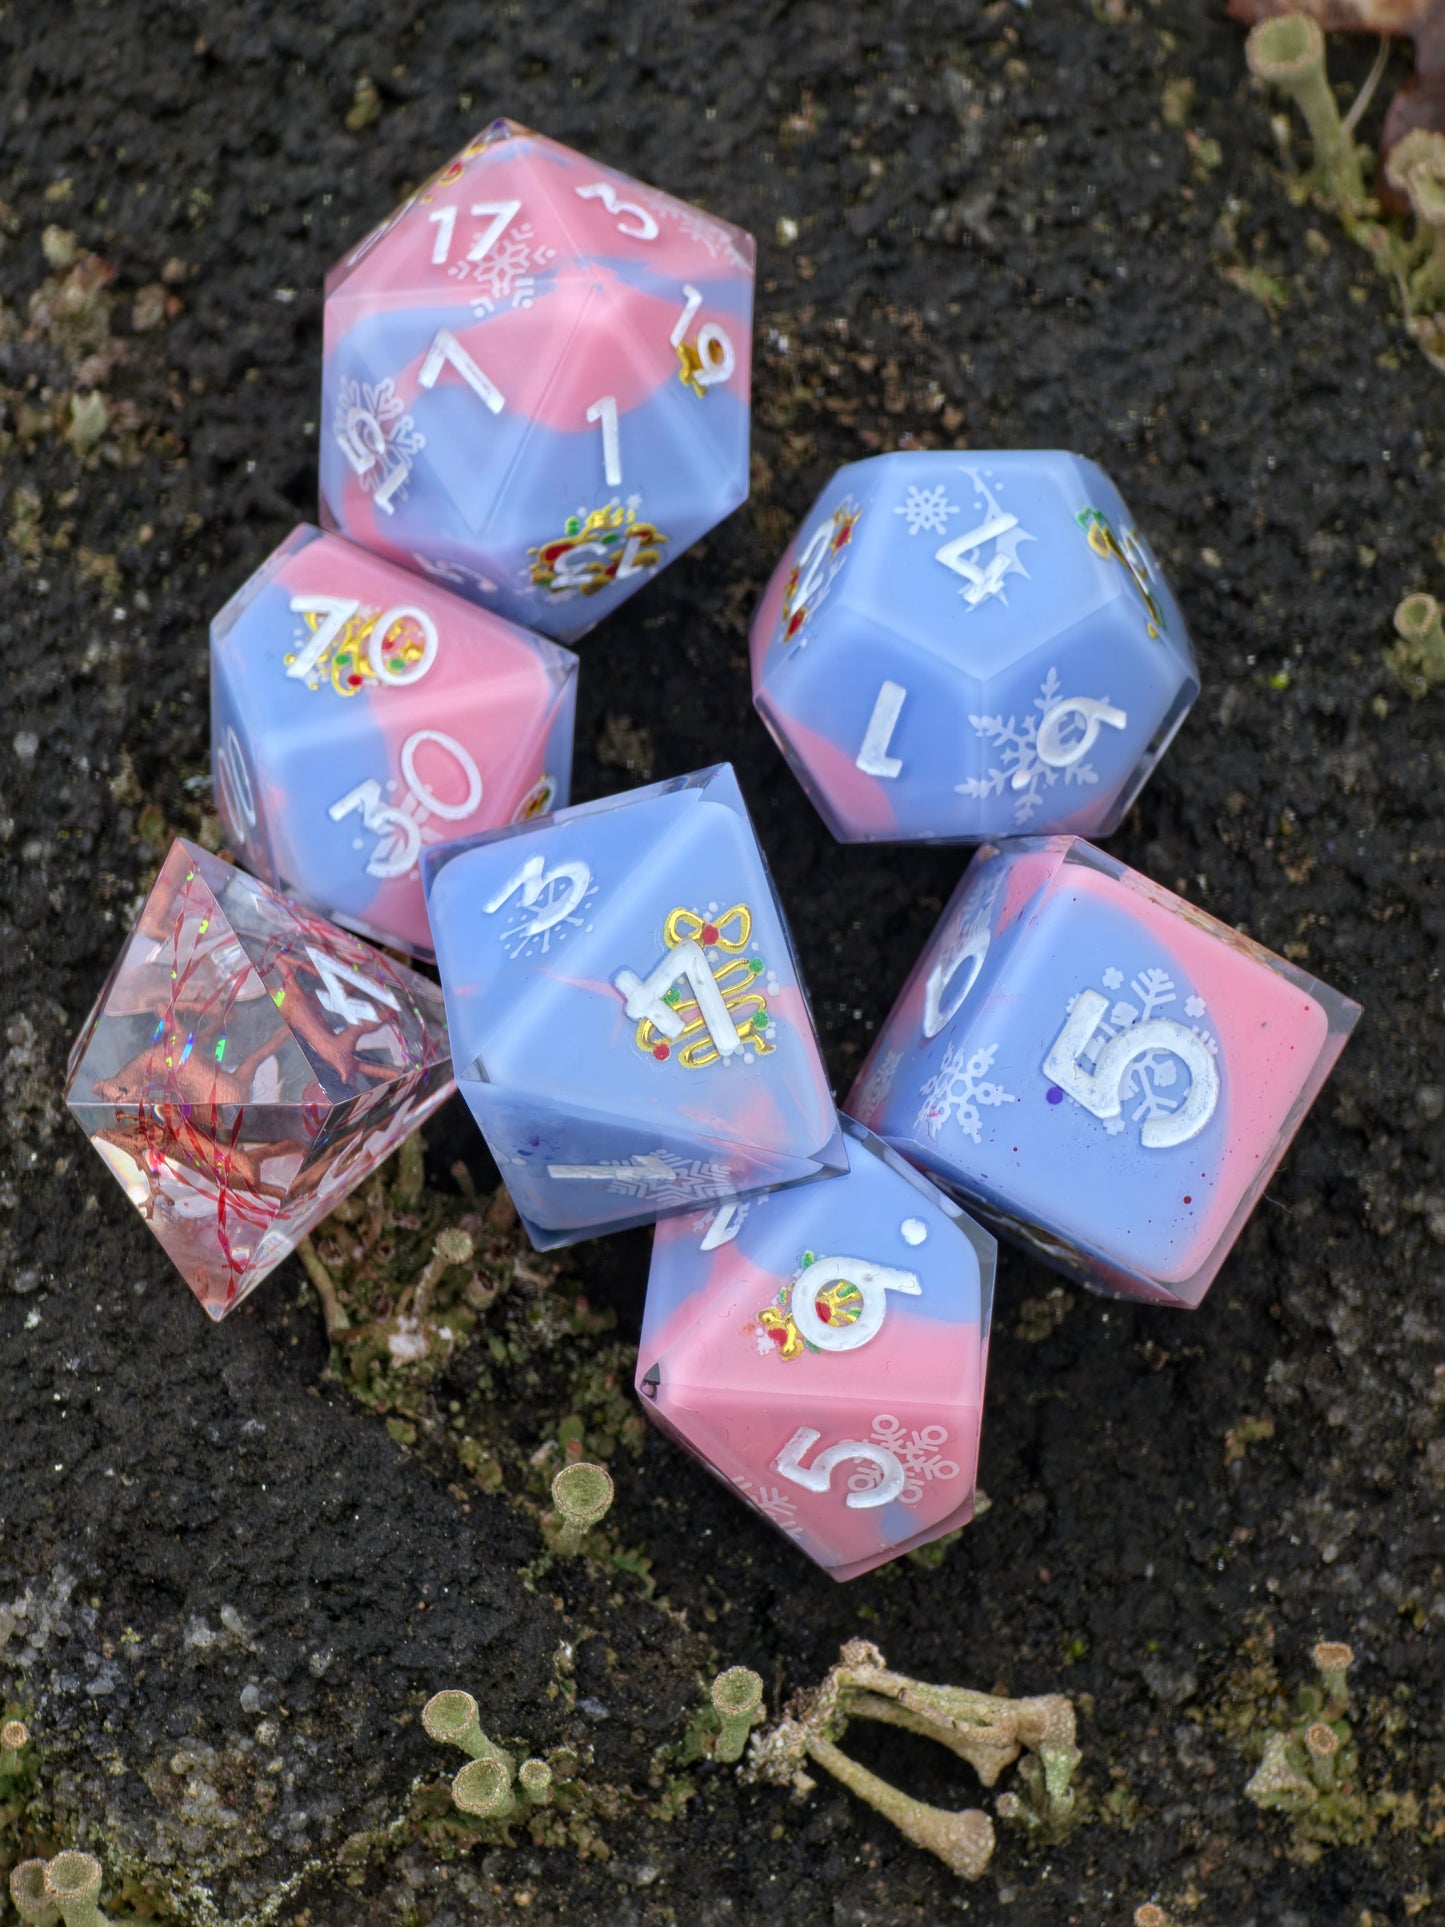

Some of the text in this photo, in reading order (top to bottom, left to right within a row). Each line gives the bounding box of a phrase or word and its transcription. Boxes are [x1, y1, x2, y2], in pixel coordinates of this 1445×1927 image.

[429, 201, 522, 264] 17
[575, 182, 660, 240] 3
[419, 328, 505, 415] 7
[586, 396, 622, 486] 1
[935, 512, 1018, 605] 4
[285, 595, 439, 687] 70
[856, 680, 906, 779] 1
[328, 729, 483, 879] 30
[304, 944, 402, 1026] 4
[1042, 989, 1222, 1149] 5
[771, 1426, 906, 1510] 5
